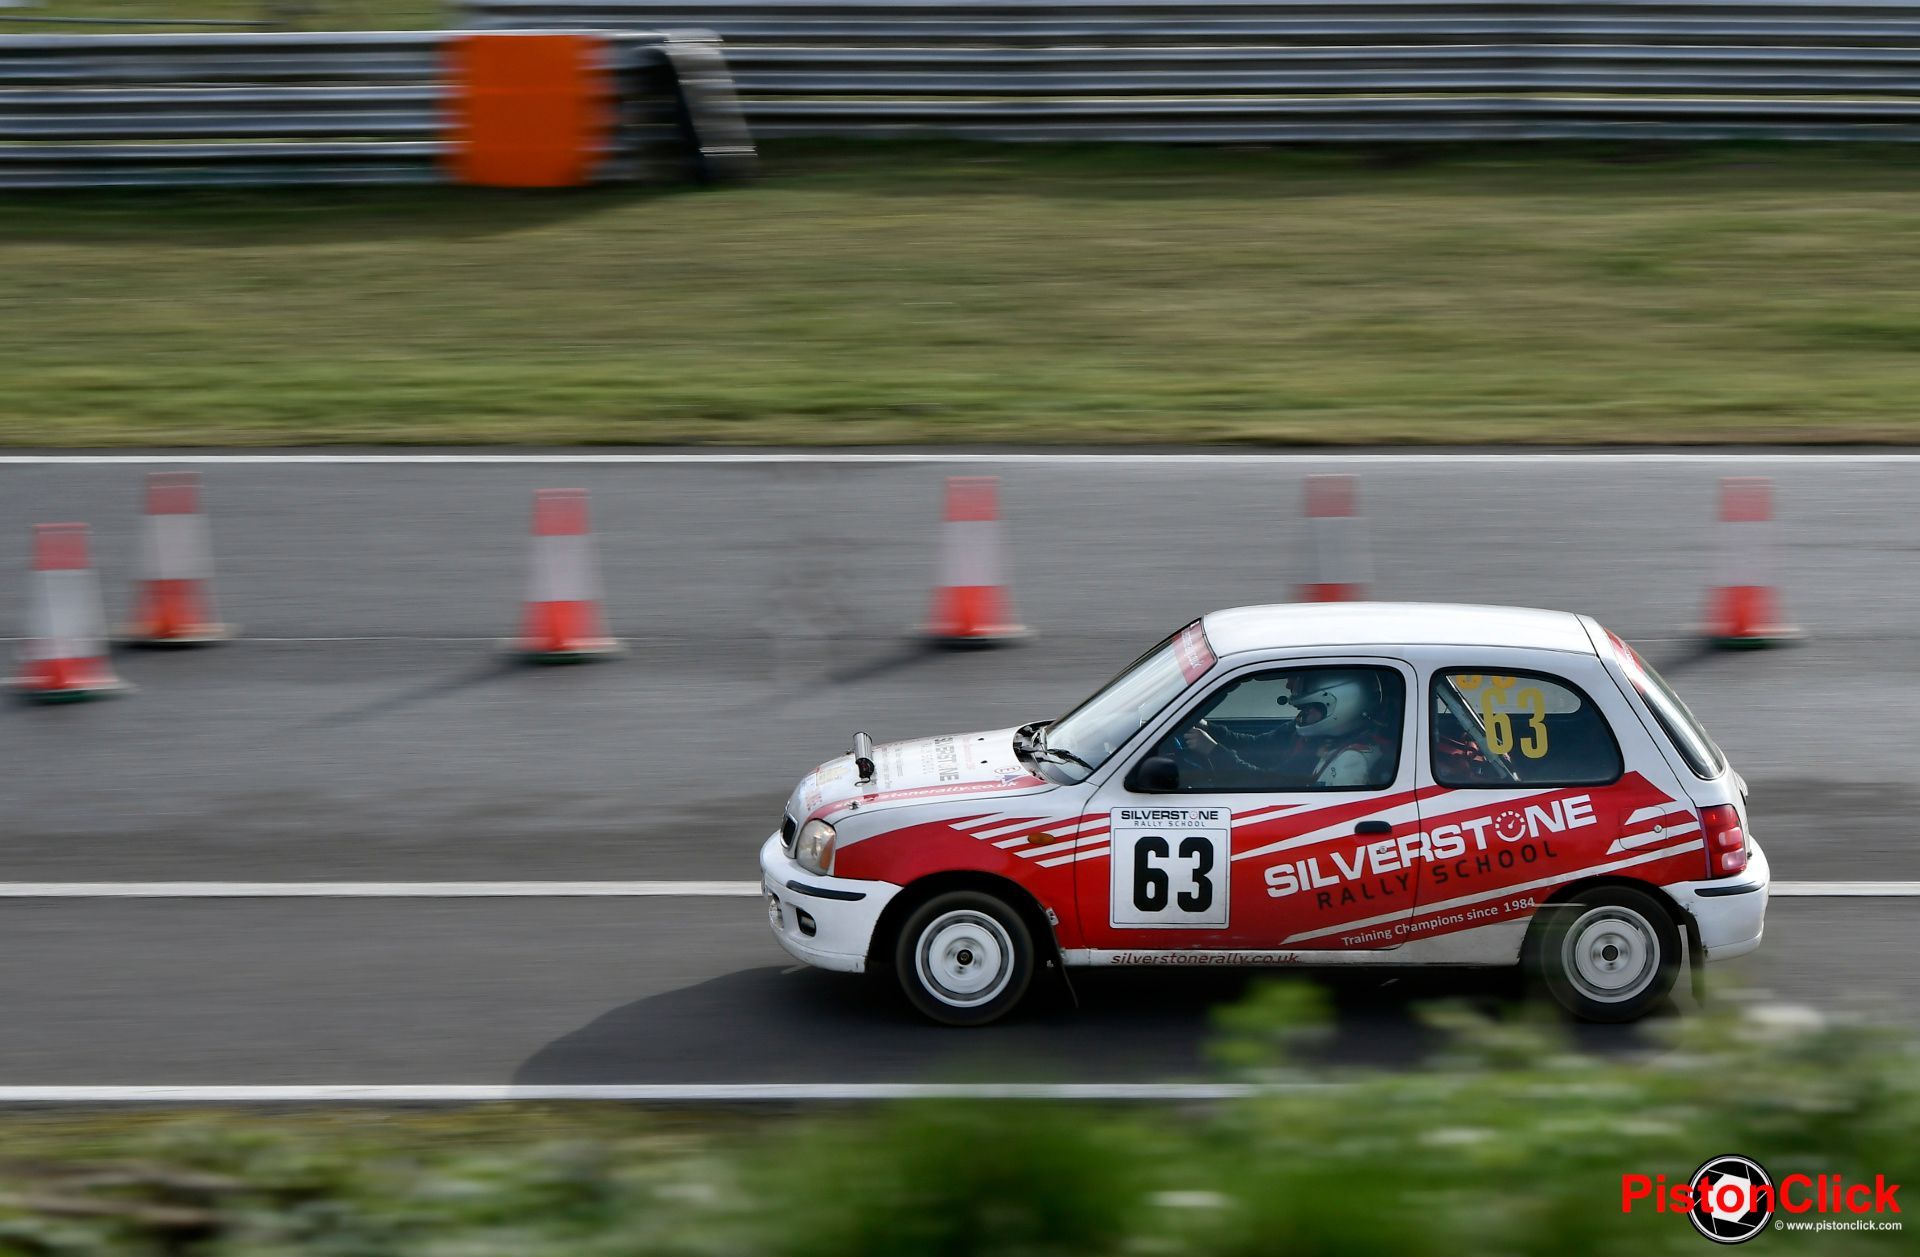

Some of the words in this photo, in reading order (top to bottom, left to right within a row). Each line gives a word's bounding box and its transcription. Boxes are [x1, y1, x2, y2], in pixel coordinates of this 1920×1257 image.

[1481, 687, 1548, 759] 63
[1121, 810, 1219, 820] SILVERSTONE
[1263, 794, 1598, 898] SILVERSTONE
[1133, 836, 1214, 913] 63
[1316, 872, 1409, 910] RALLY
[1432, 840, 1558, 884] SCHOOL
[1341, 928, 1393, 947] Training
[1394, 912, 1464, 936] Champions
[1467, 906, 1499, 921] since
[1504, 897, 1536, 913] 1984
[1111, 952, 1300, 966] silverstonerally.co.uk
